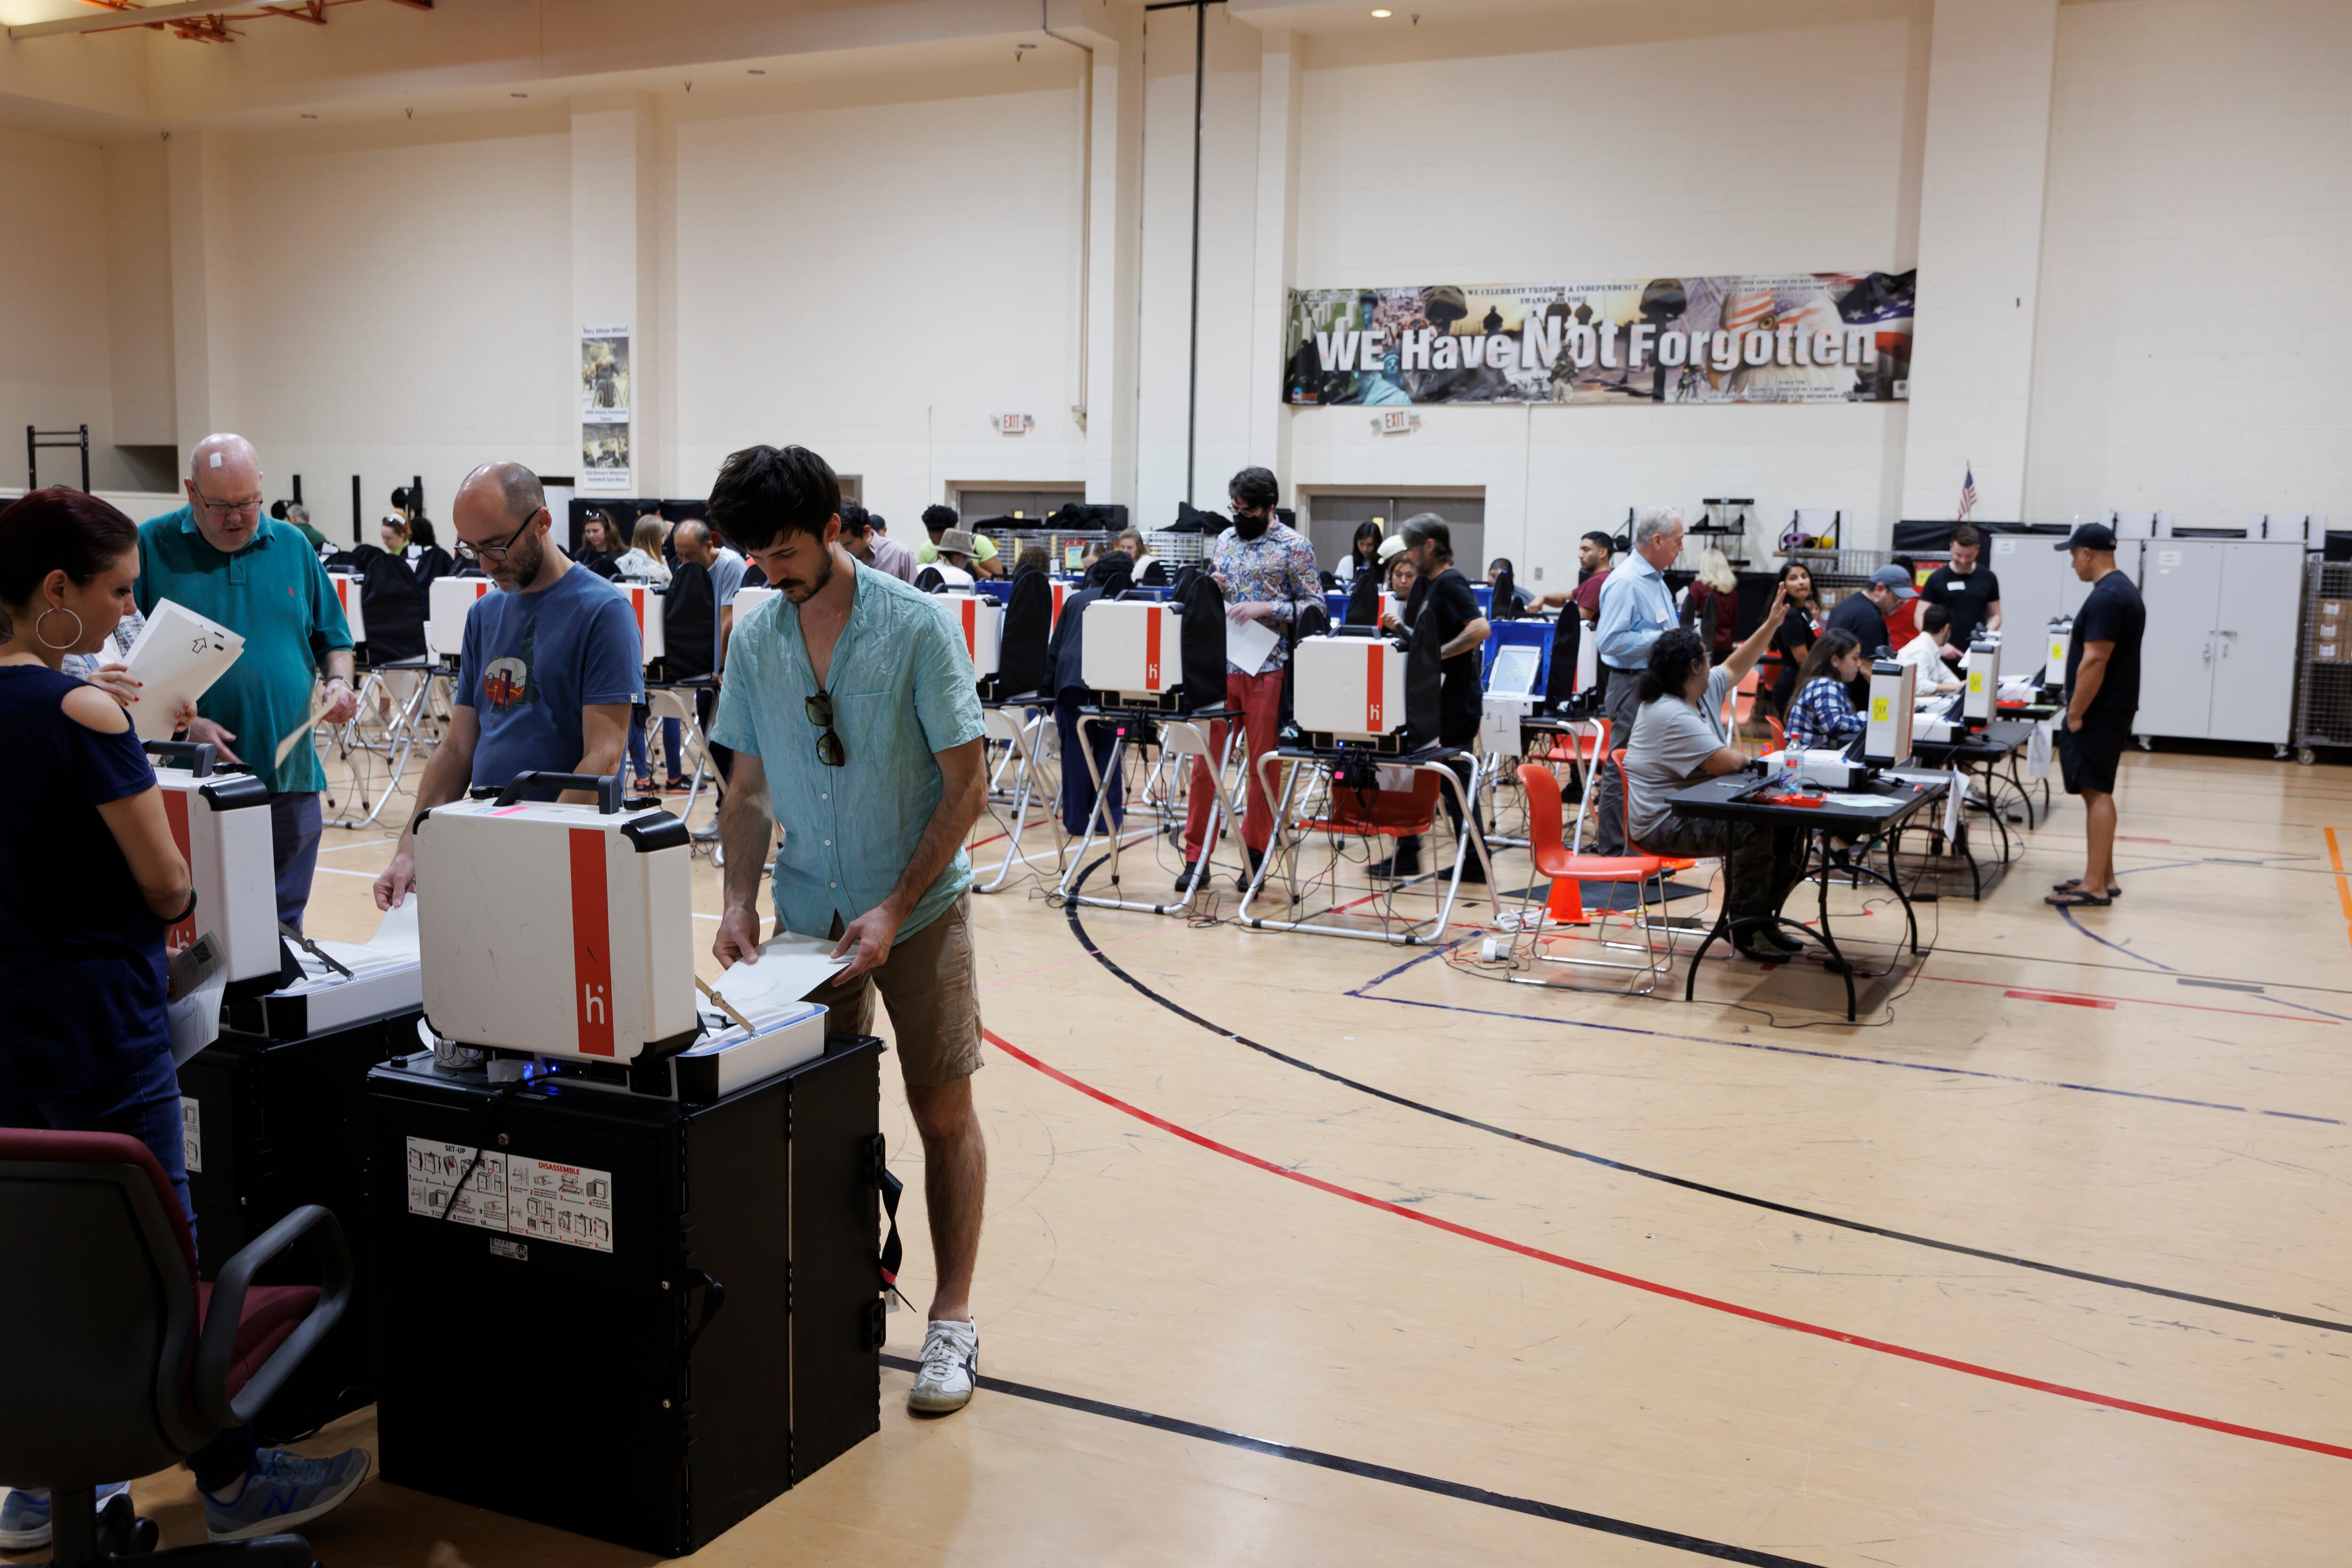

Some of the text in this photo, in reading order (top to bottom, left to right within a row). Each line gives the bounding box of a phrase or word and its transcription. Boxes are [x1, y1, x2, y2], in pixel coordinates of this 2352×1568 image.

[1317, 316, 1877, 371] WE Have Not Forgotten
[1003, 414, 1020, 429] EXIT
[1385, 412, 1405, 429] EXIT
[445, 1145, 466, 1154] SET-UP
[538, 1162, 580, 1175] DISASSEMBLE
[262, 1486, 301, 1515] N
